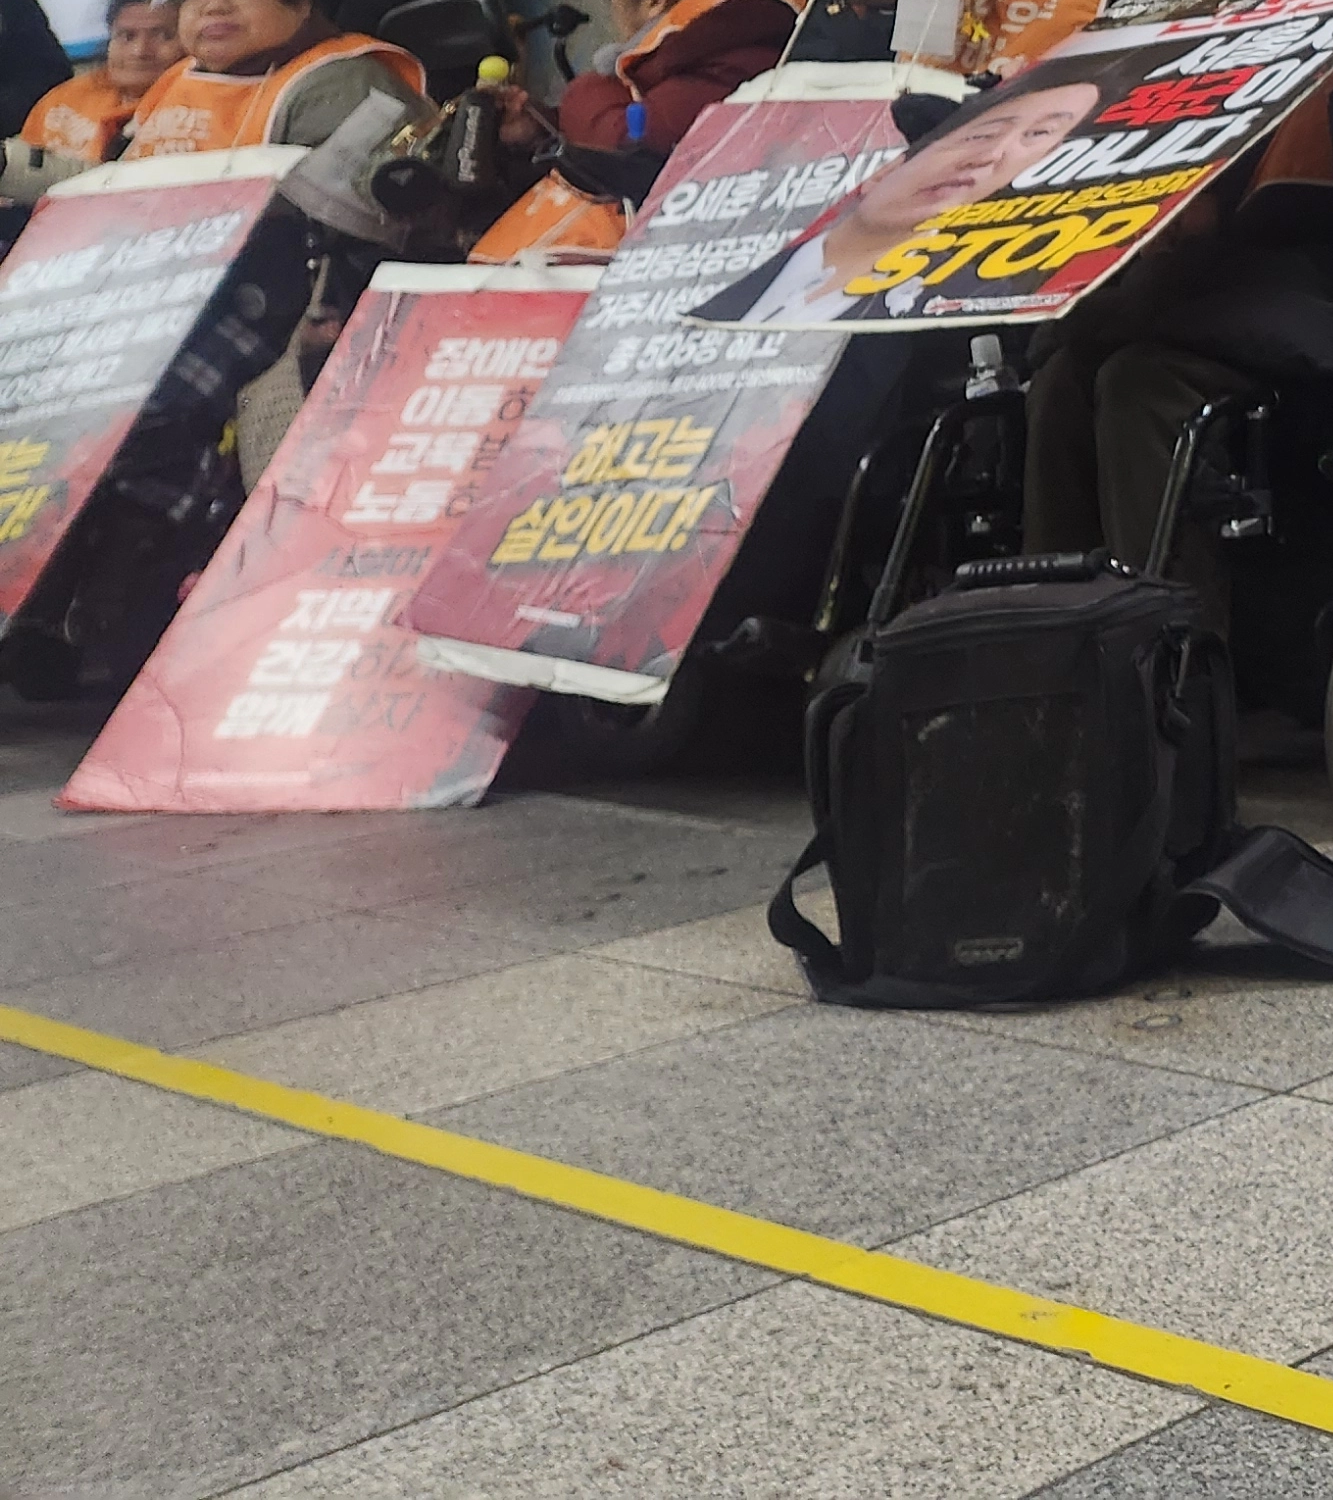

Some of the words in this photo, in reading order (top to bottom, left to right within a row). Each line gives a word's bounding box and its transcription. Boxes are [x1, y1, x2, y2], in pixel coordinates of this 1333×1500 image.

[1094, 51, 1333, 125] 적군이
[1010, 107, 1264, 190] 아니다
[648, 169, 769, 229] 오세훈
[844, 204, 1159, 295] STOP
[560, 414, 716, 490] 해고는
[491, 478, 717, 566] 살인이다!
